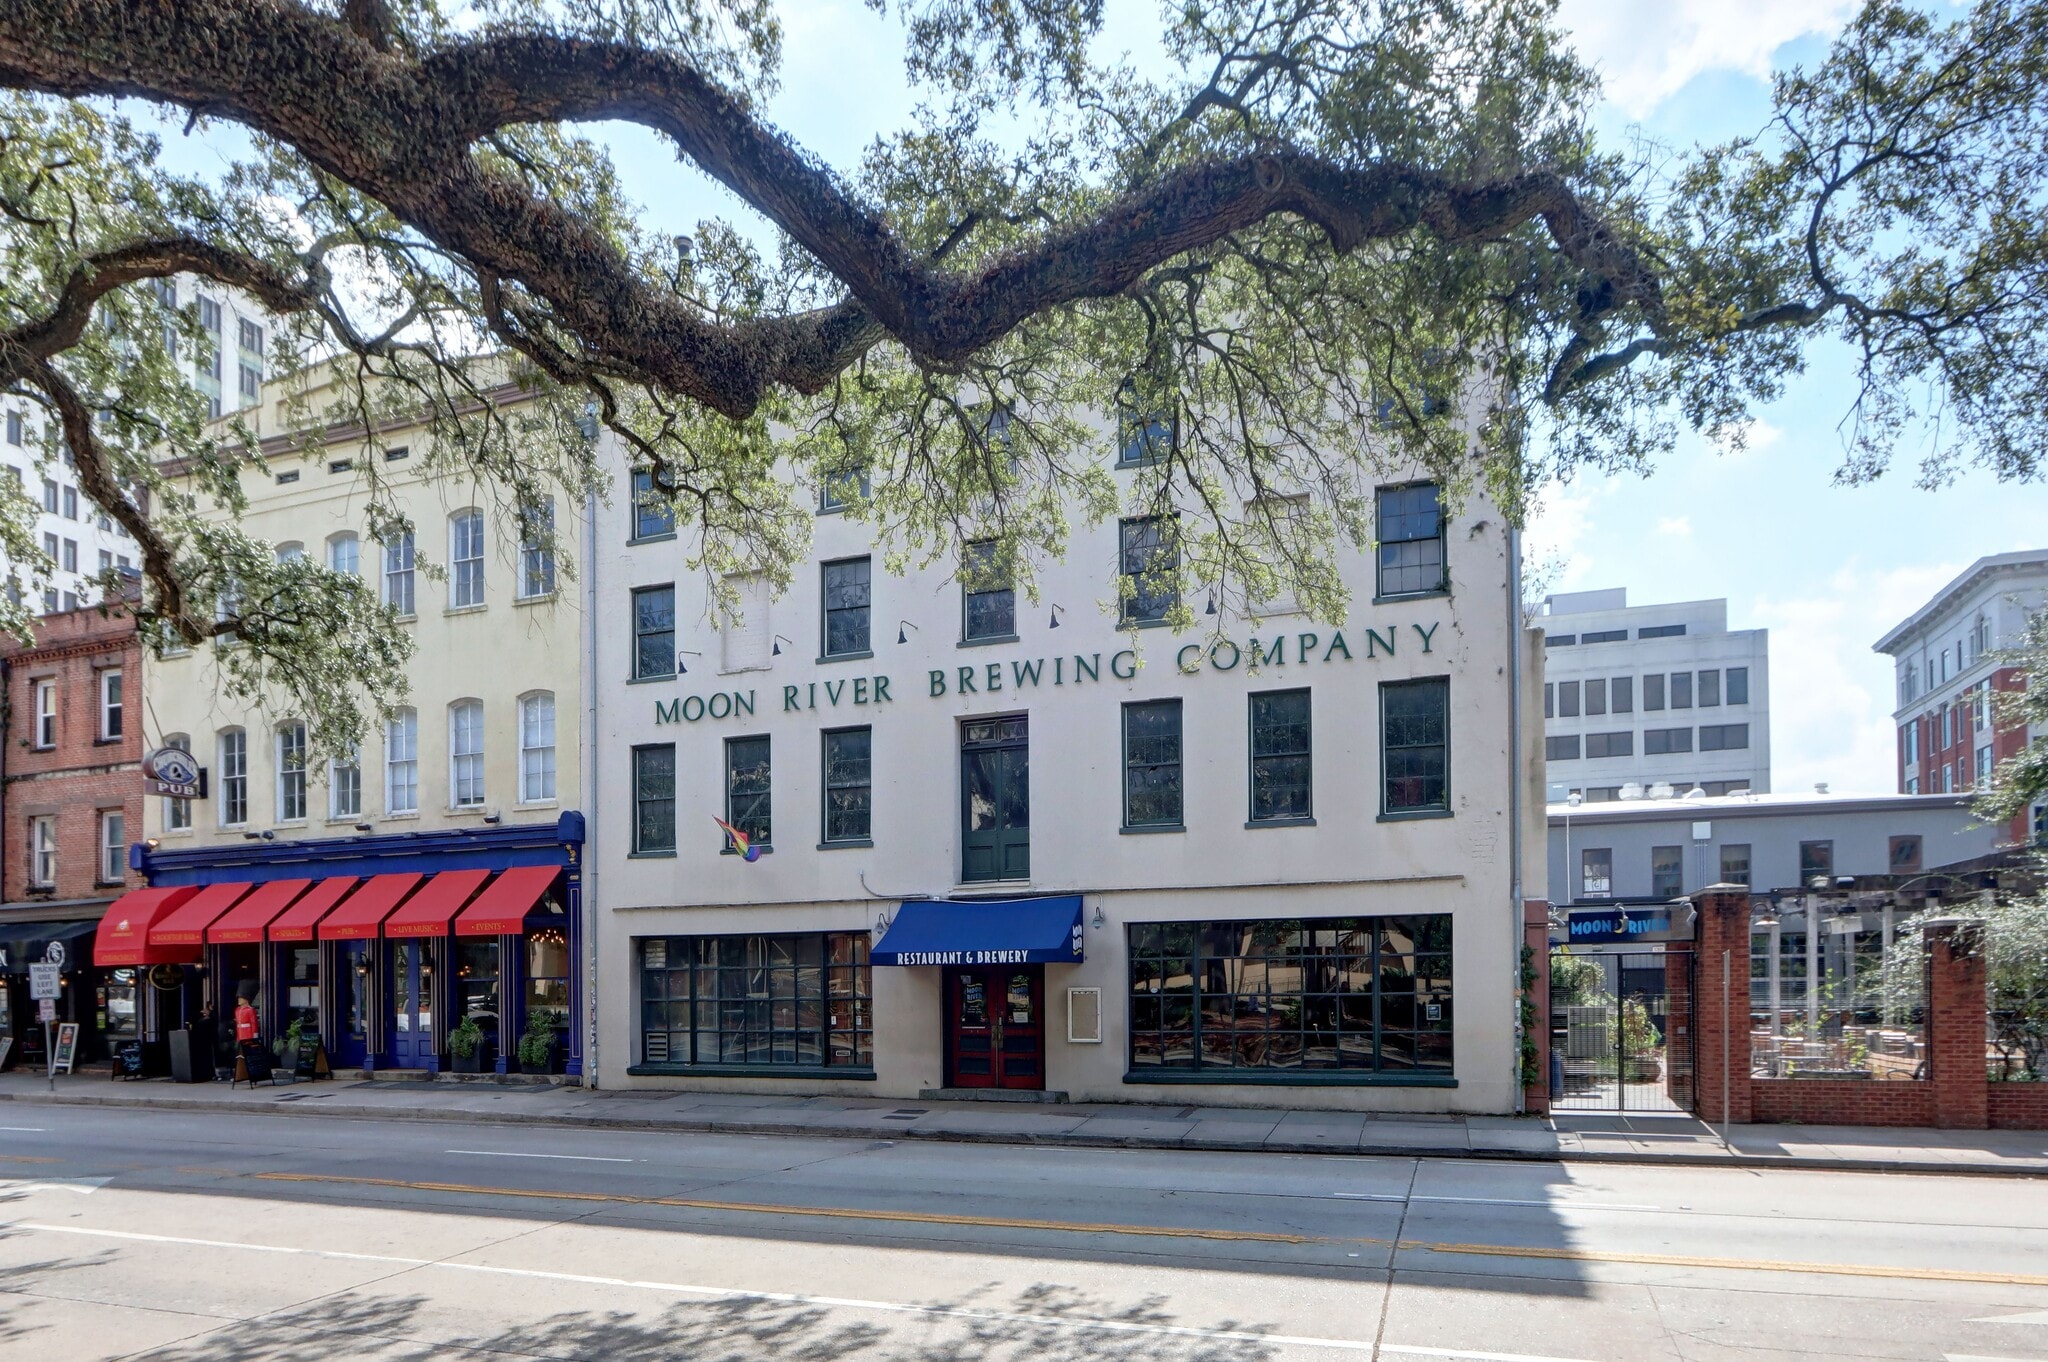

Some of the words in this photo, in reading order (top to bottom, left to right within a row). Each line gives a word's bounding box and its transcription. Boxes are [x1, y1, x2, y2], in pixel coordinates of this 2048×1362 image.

[655, 689, 757, 725] MOON
[783, 675, 893, 712] RIVER
[928, 650, 1136, 698] BREWING
[1177, 621, 1440, 674] COMPANY
[157, 783, 195, 795] PUB
[398, 926, 413, 934] LIVE
[413, 925, 435, 933] MUSIC
[475, 923, 501, 931] EVENTS
[1571, 919, 1612, 935] MOON
[897, 951, 962, 966] RESTAURANT
[966, 951, 974, 964] &
[977, 949, 1029, 964] BREWERY
[37, 988, 54, 996] LANE
